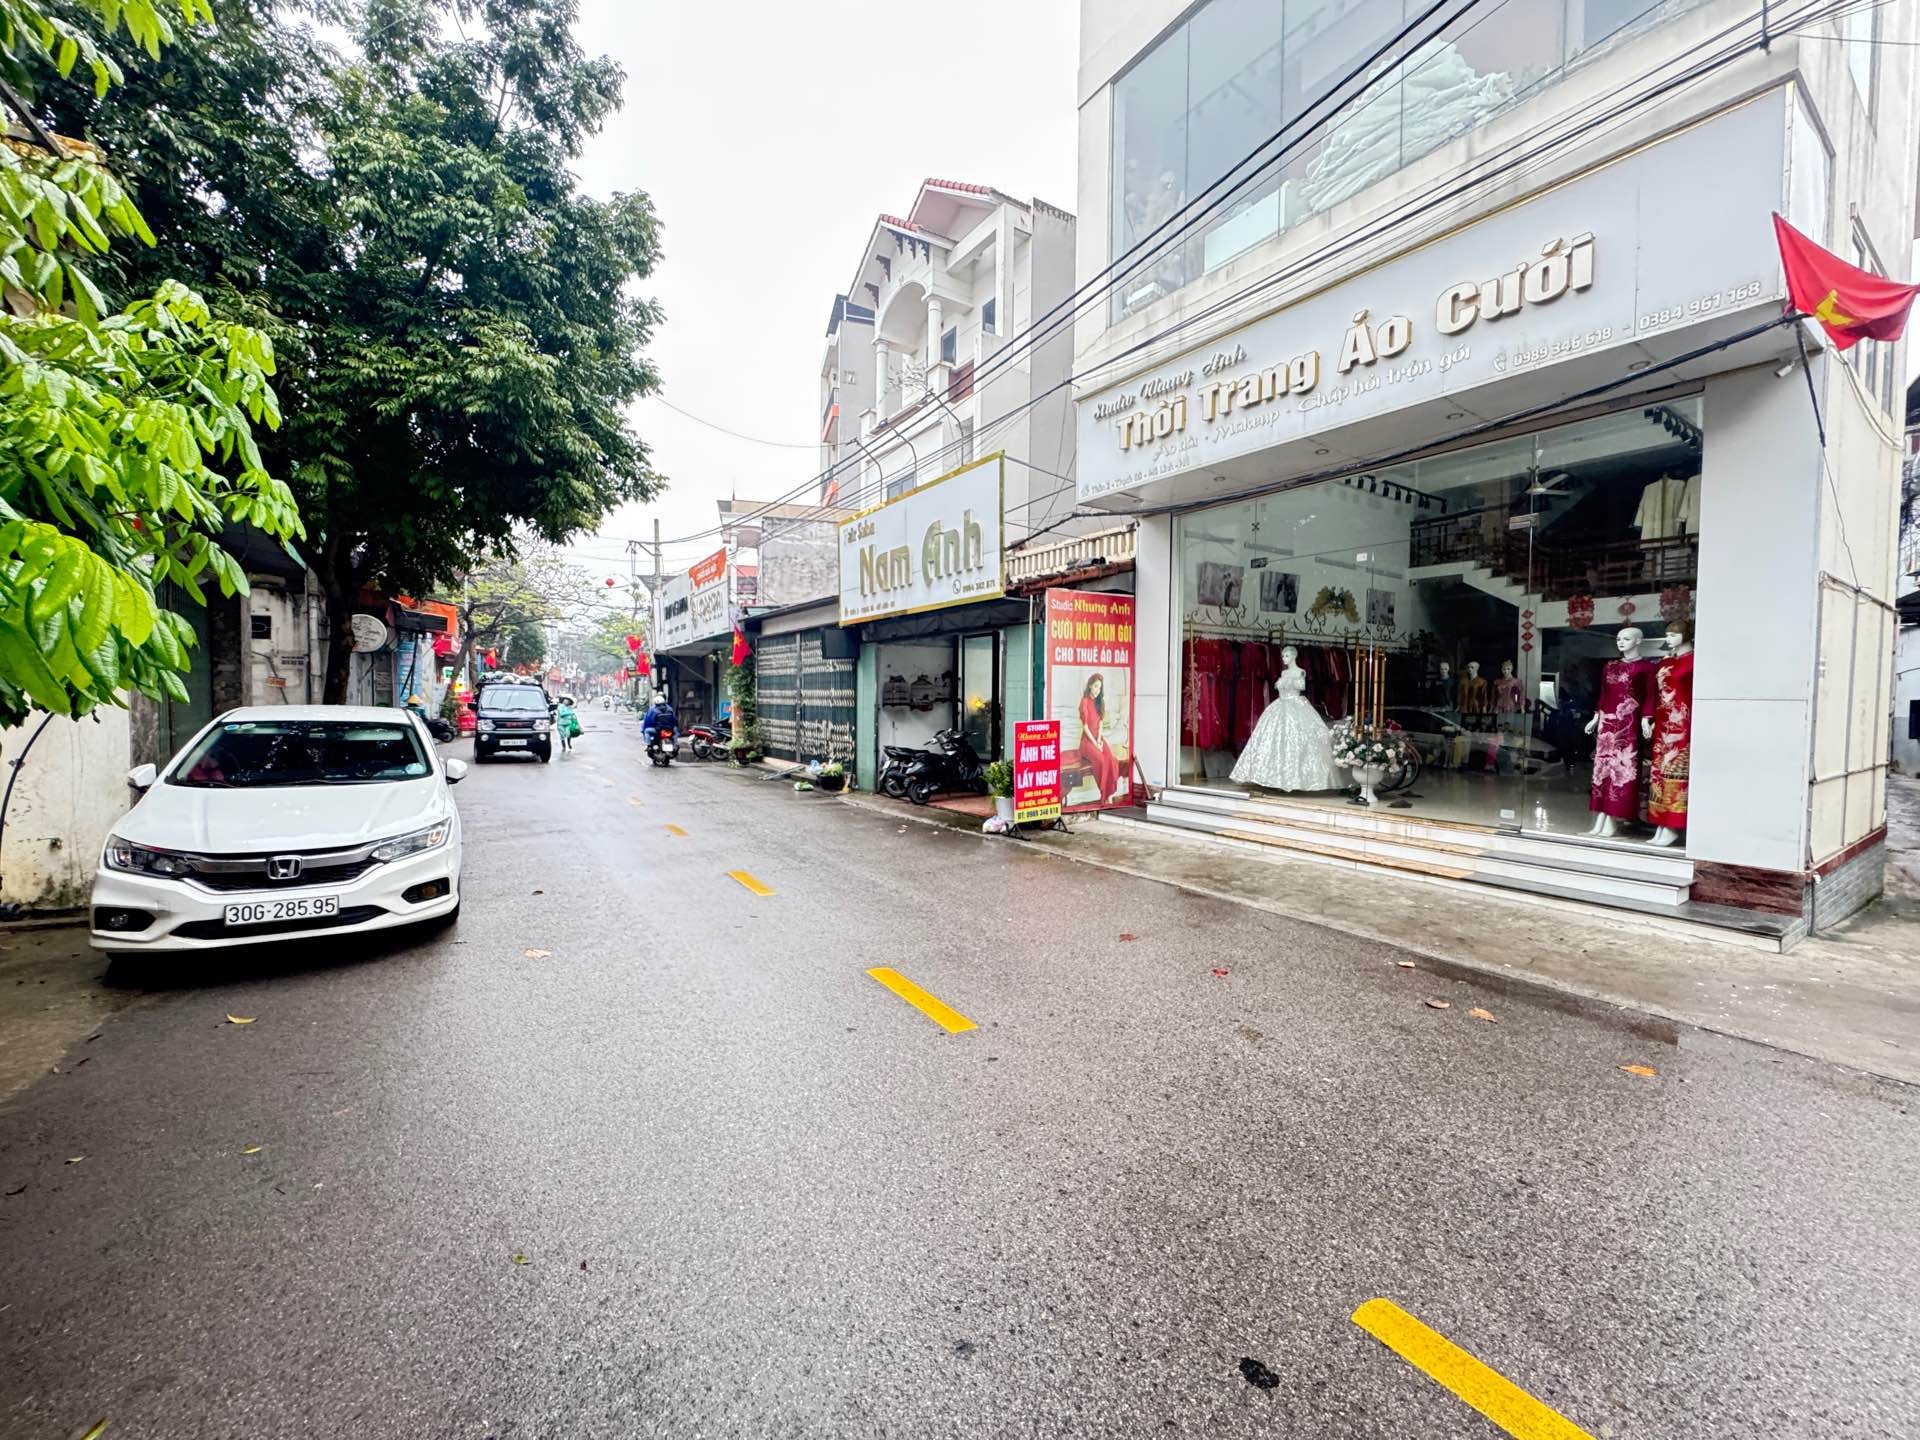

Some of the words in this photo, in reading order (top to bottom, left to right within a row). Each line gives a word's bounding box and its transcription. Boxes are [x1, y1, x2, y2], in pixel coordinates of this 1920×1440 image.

[1116, 395, 1187, 451] Thời
[1198, 349, 1320, 422] Trang
[1337, 309, 1413, 372] Áo
[1436, 231, 1596, 337] Cưới
[1513, 346, 1548, 366] 0989
[1551, 336, 1582, 356] 346
[1639, 304, 1684, 330] 0384
[1140, 369, 1195, 400] Nhung
[859, 543, 912, 597] Nam
[1074, 598, 1107, 618] Nhung
[1110, 601, 1131, 616] Anh
[1055, 646, 1074, 663] CHO
[1076, 645, 1098, 663] THUÊ
[1100, 645, 1112, 664] ÁO
[1019, 741, 1039, 763] ẢNH
[1017, 767, 1035, 790] LẤY
[1035, 770, 1058, 788] NGAY
[228, 898, 336, 923] 30G-285.95
